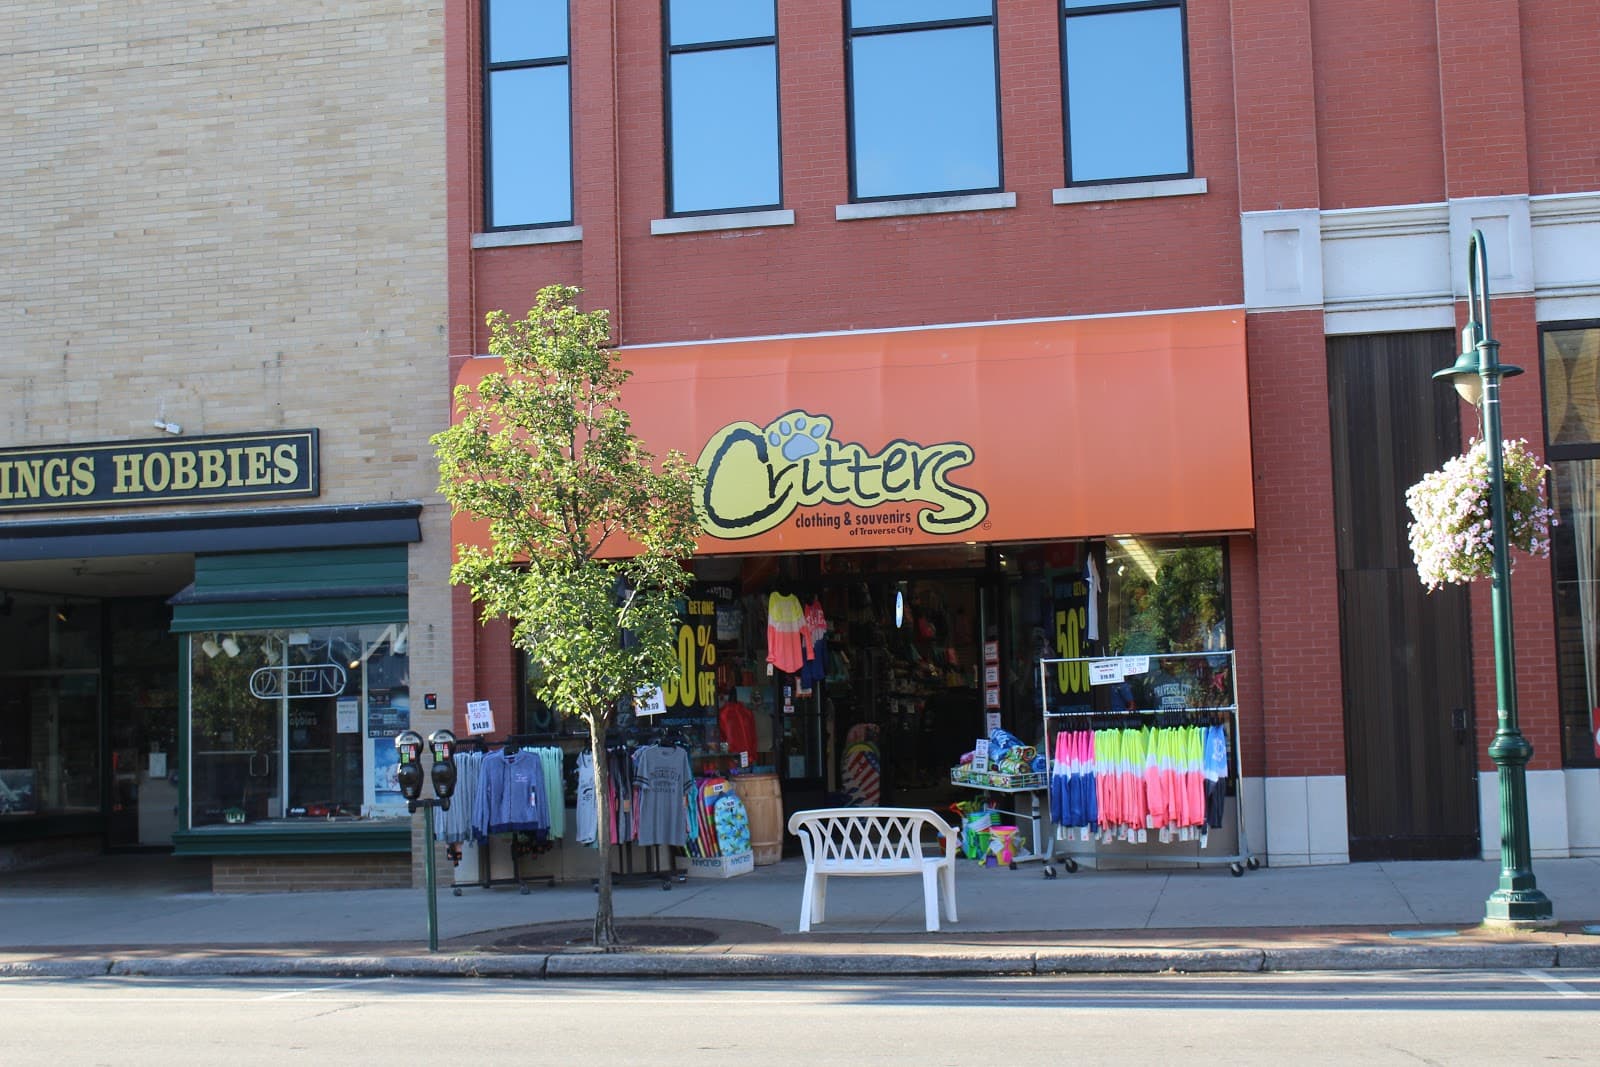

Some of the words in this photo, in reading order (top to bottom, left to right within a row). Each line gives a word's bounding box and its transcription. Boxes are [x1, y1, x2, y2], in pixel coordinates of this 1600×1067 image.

[0, 456, 95, 499] INGS
[112, 444, 298, 493] HOBBIES
[704, 427, 977, 529] Critters
[795, 511, 841, 530] clothing
[843, 512, 852, 524] &
[855, 509, 911, 525] souvenirs
[849, 526, 859, 536] of
[859, 526, 896, 536] Traverse
[897, 524, 914, 535] City
[688, 600, 701, 615] GET
[701, 600, 715, 615] ONE
[698, 671, 716, 707] OFF
